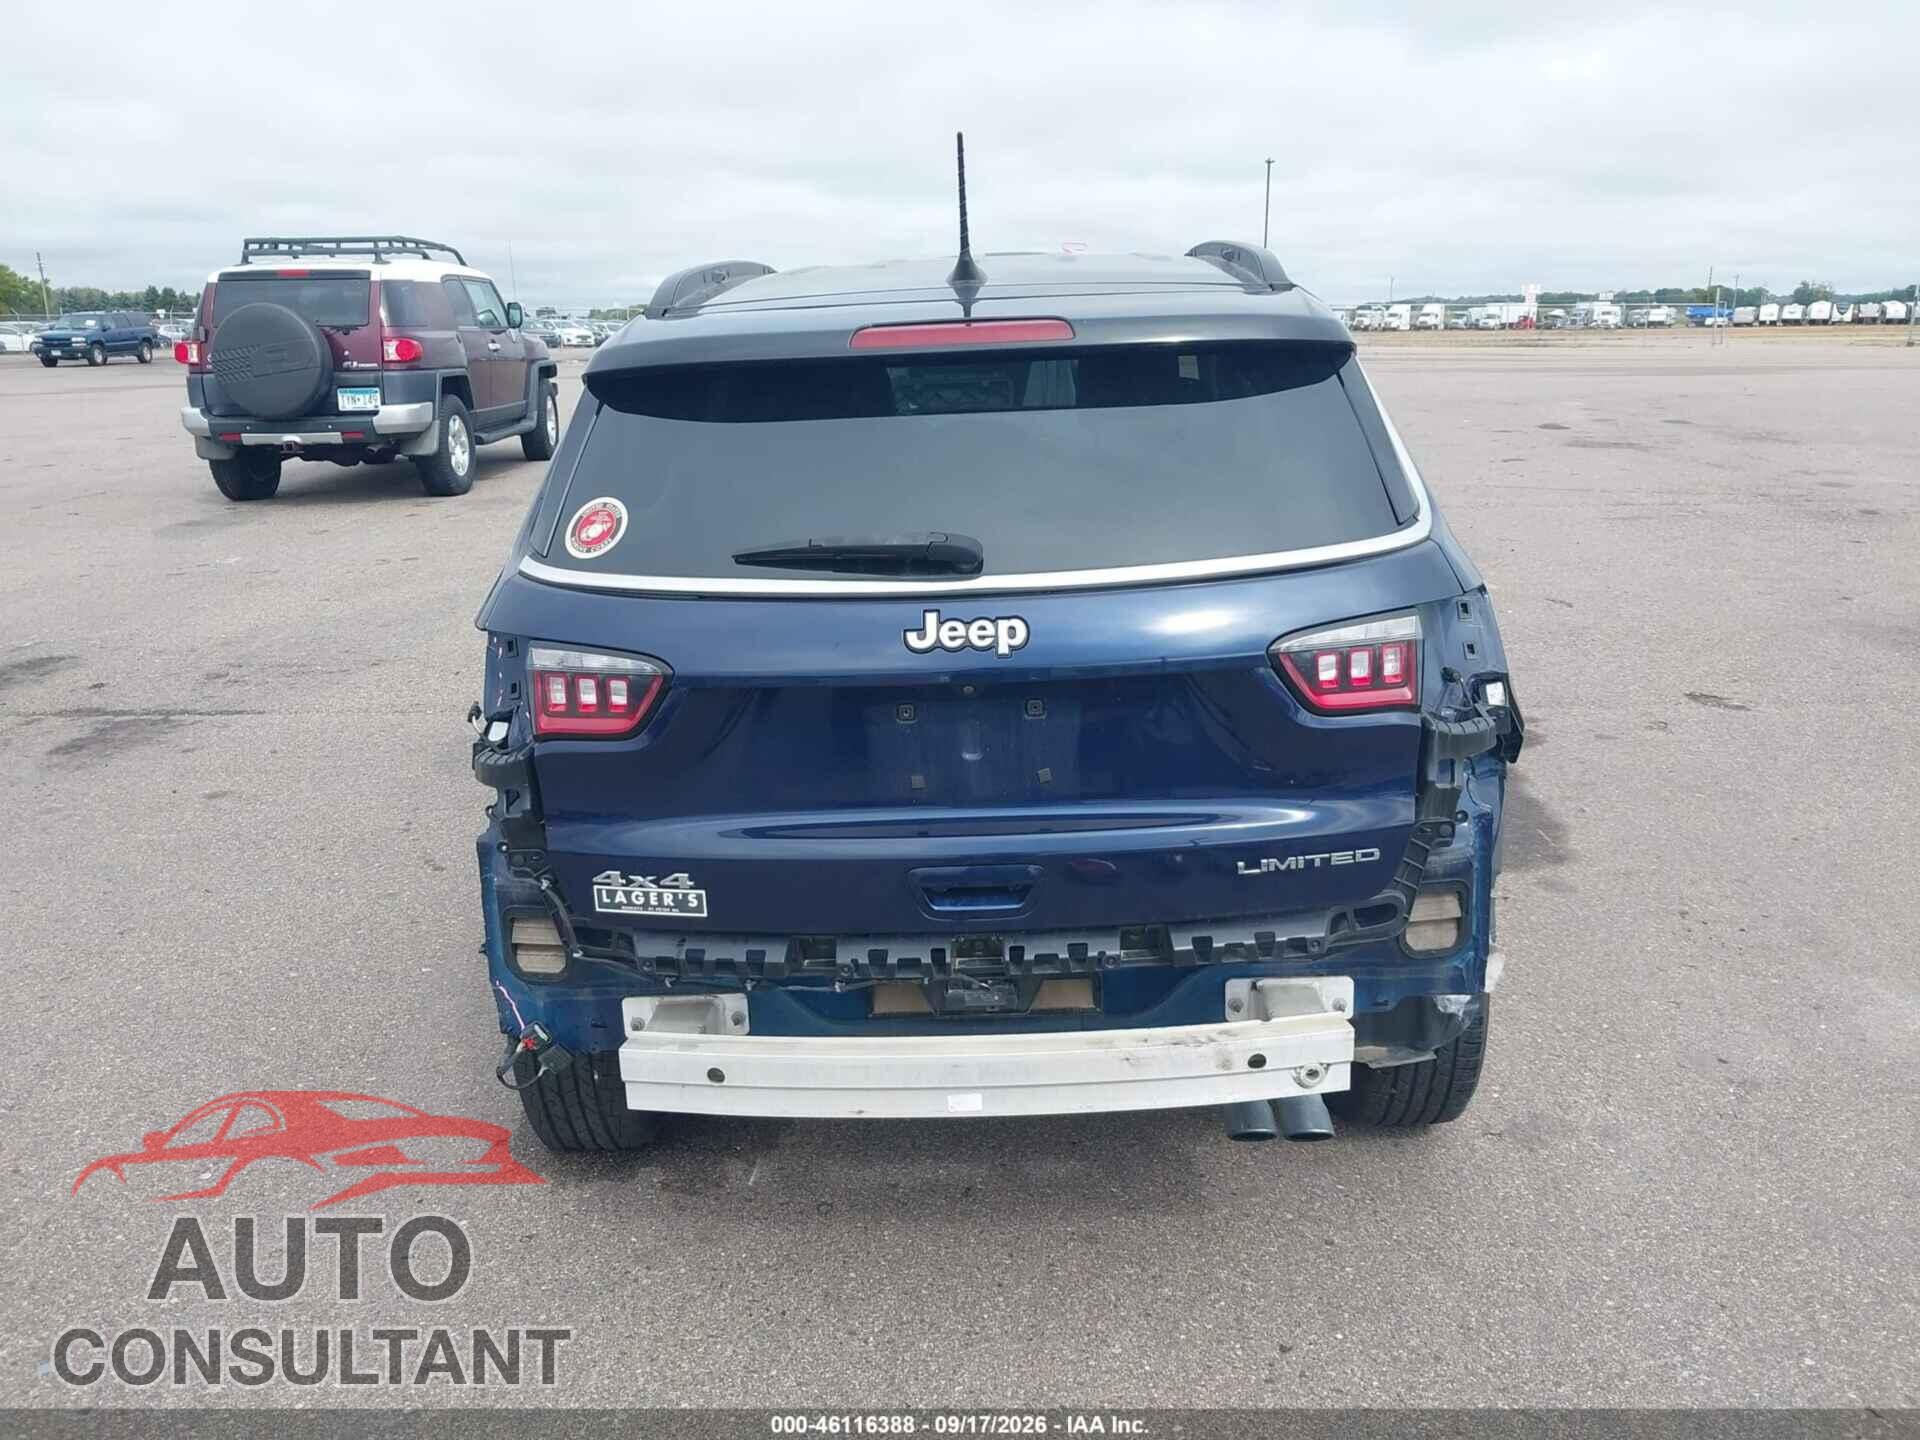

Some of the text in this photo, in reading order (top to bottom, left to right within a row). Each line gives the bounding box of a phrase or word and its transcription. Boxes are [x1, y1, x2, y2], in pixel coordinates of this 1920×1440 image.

[904, 609, 1029, 658] Jeep
[1237, 848, 1381, 875] LIMITED
[592, 870, 695, 888] 4x4
[601, 889, 698, 907] LAGER'S
